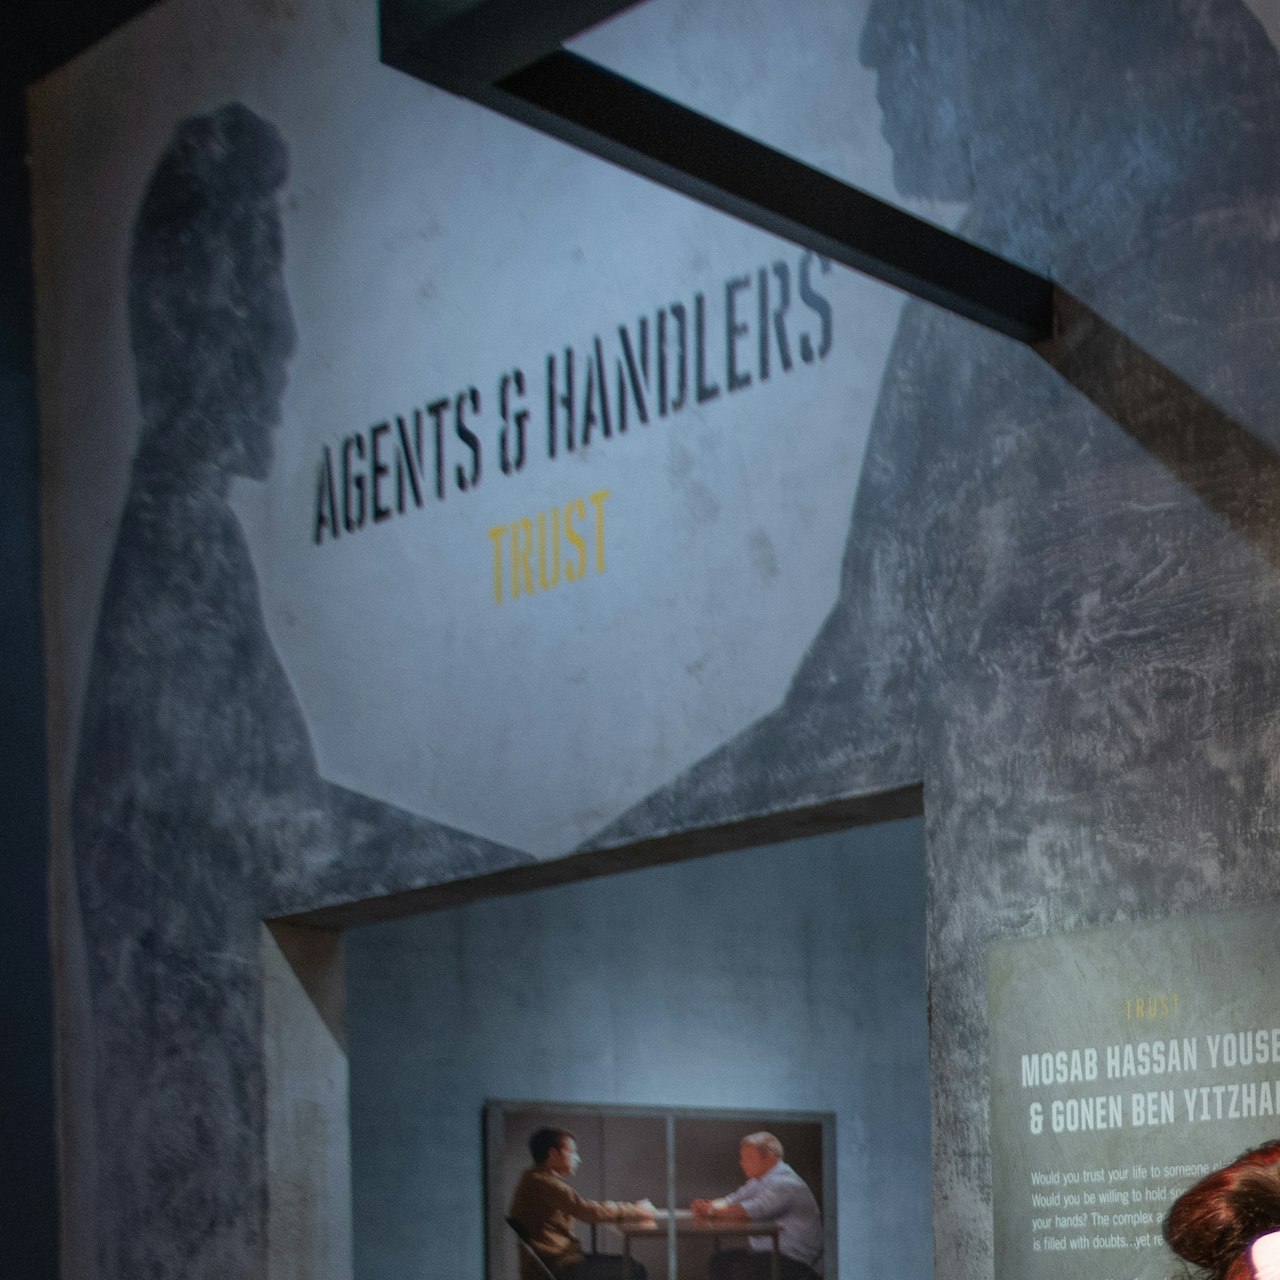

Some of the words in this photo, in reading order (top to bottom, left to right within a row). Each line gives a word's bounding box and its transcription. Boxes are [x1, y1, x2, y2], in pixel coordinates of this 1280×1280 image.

[313, 384, 482, 545] AGENTS
[499, 369, 530, 476] &
[547, 250, 833, 460] HANDLERS
[487, 488, 611, 606] TRUST
[1124, 993, 1178, 1020] TRUST
[1022, 1048, 1098, 1087] MOSAB
[1107, 1038, 1197, 1078] HASSAN
[1030, 1102, 1043, 1134] &
[1052, 1094, 1122, 1133] GONEN
[1132, 1090, 1174, 1127] BEN
[1031, 1172, 1060, 1185] Would
[1062, 1174, 1079, 1186] you
[1083, 1171, 1104, 1182] trust
[1108, 1169, 1128, 1183] your
[1133, 1165, 1147, 1179] life
[1151, 1166, 1160, 1178] to
[1164, 1165, 1209, 1177] someone
